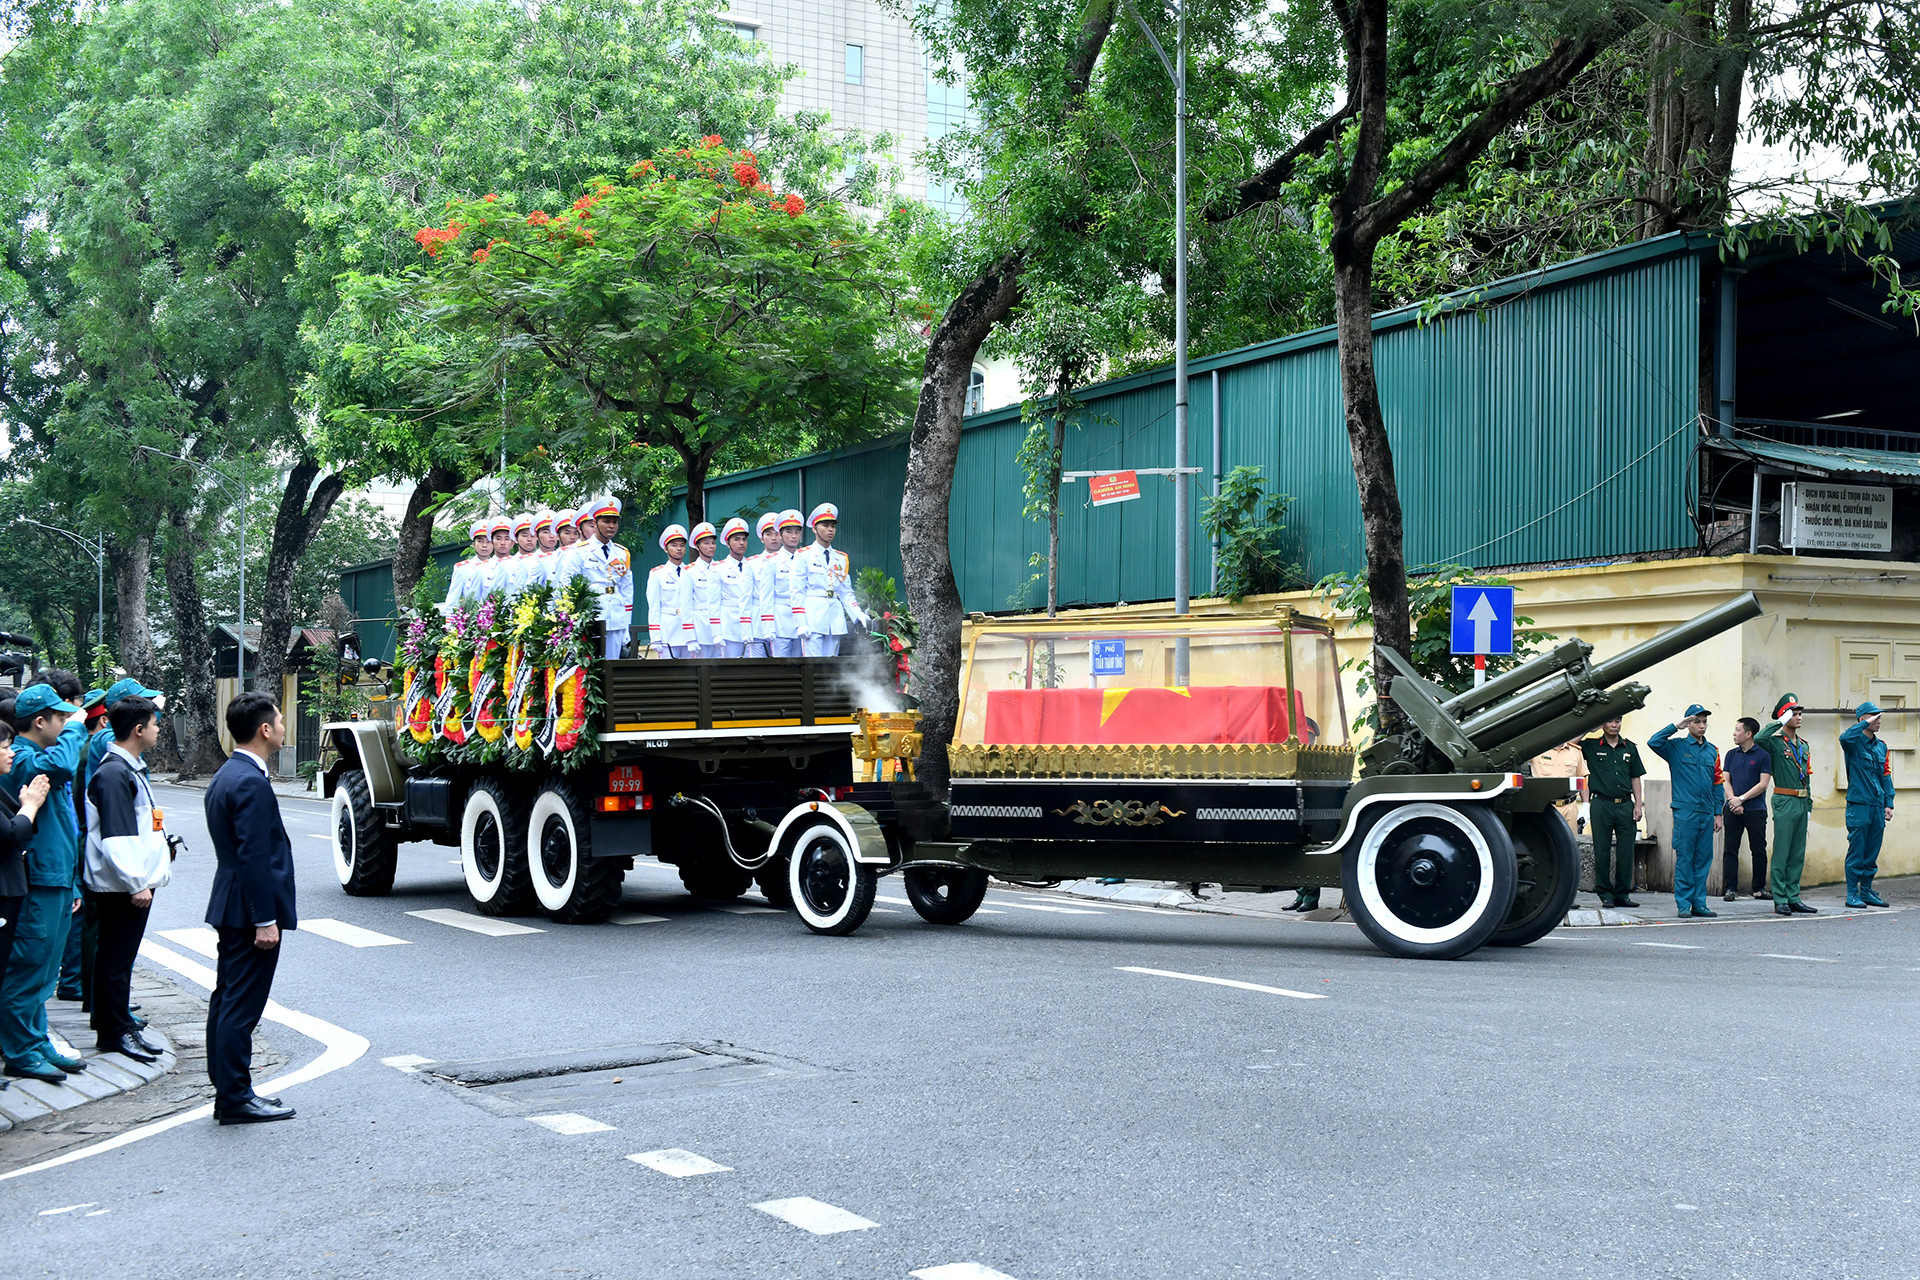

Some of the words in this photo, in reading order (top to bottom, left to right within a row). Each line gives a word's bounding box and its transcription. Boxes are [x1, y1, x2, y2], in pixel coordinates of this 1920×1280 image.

[1806, 489, 1818, 499] DỊCH
[1819, 490, 1825, 500] VỤ
[1827, 490, 1839, 499] TANG
[1848, 492, 1861, 502] TRỌN
[1862, 491, 1870, 501] GÓI
[1871, 494, 1885, 502] 24/24
[1805, 502, 1819, 513] NHẬN
[1821, 501, 1831, 512] BỐC
[1864, 505, 1872, 516] MỘ
[1805, 514, 1821, 525] THUỐC
[1822, 515, 1832, 526] BỐC
[1853, 518, 1861, 527] KHÍ
[1862, 518, 1872, 528] BẢO
[1874, 518, 1887, 530] QUẢN
[1105, 644, 1115, 652] PHỐ
[621, 766, 632, 778] TM
[612, 780, 640, 792] 99-99
